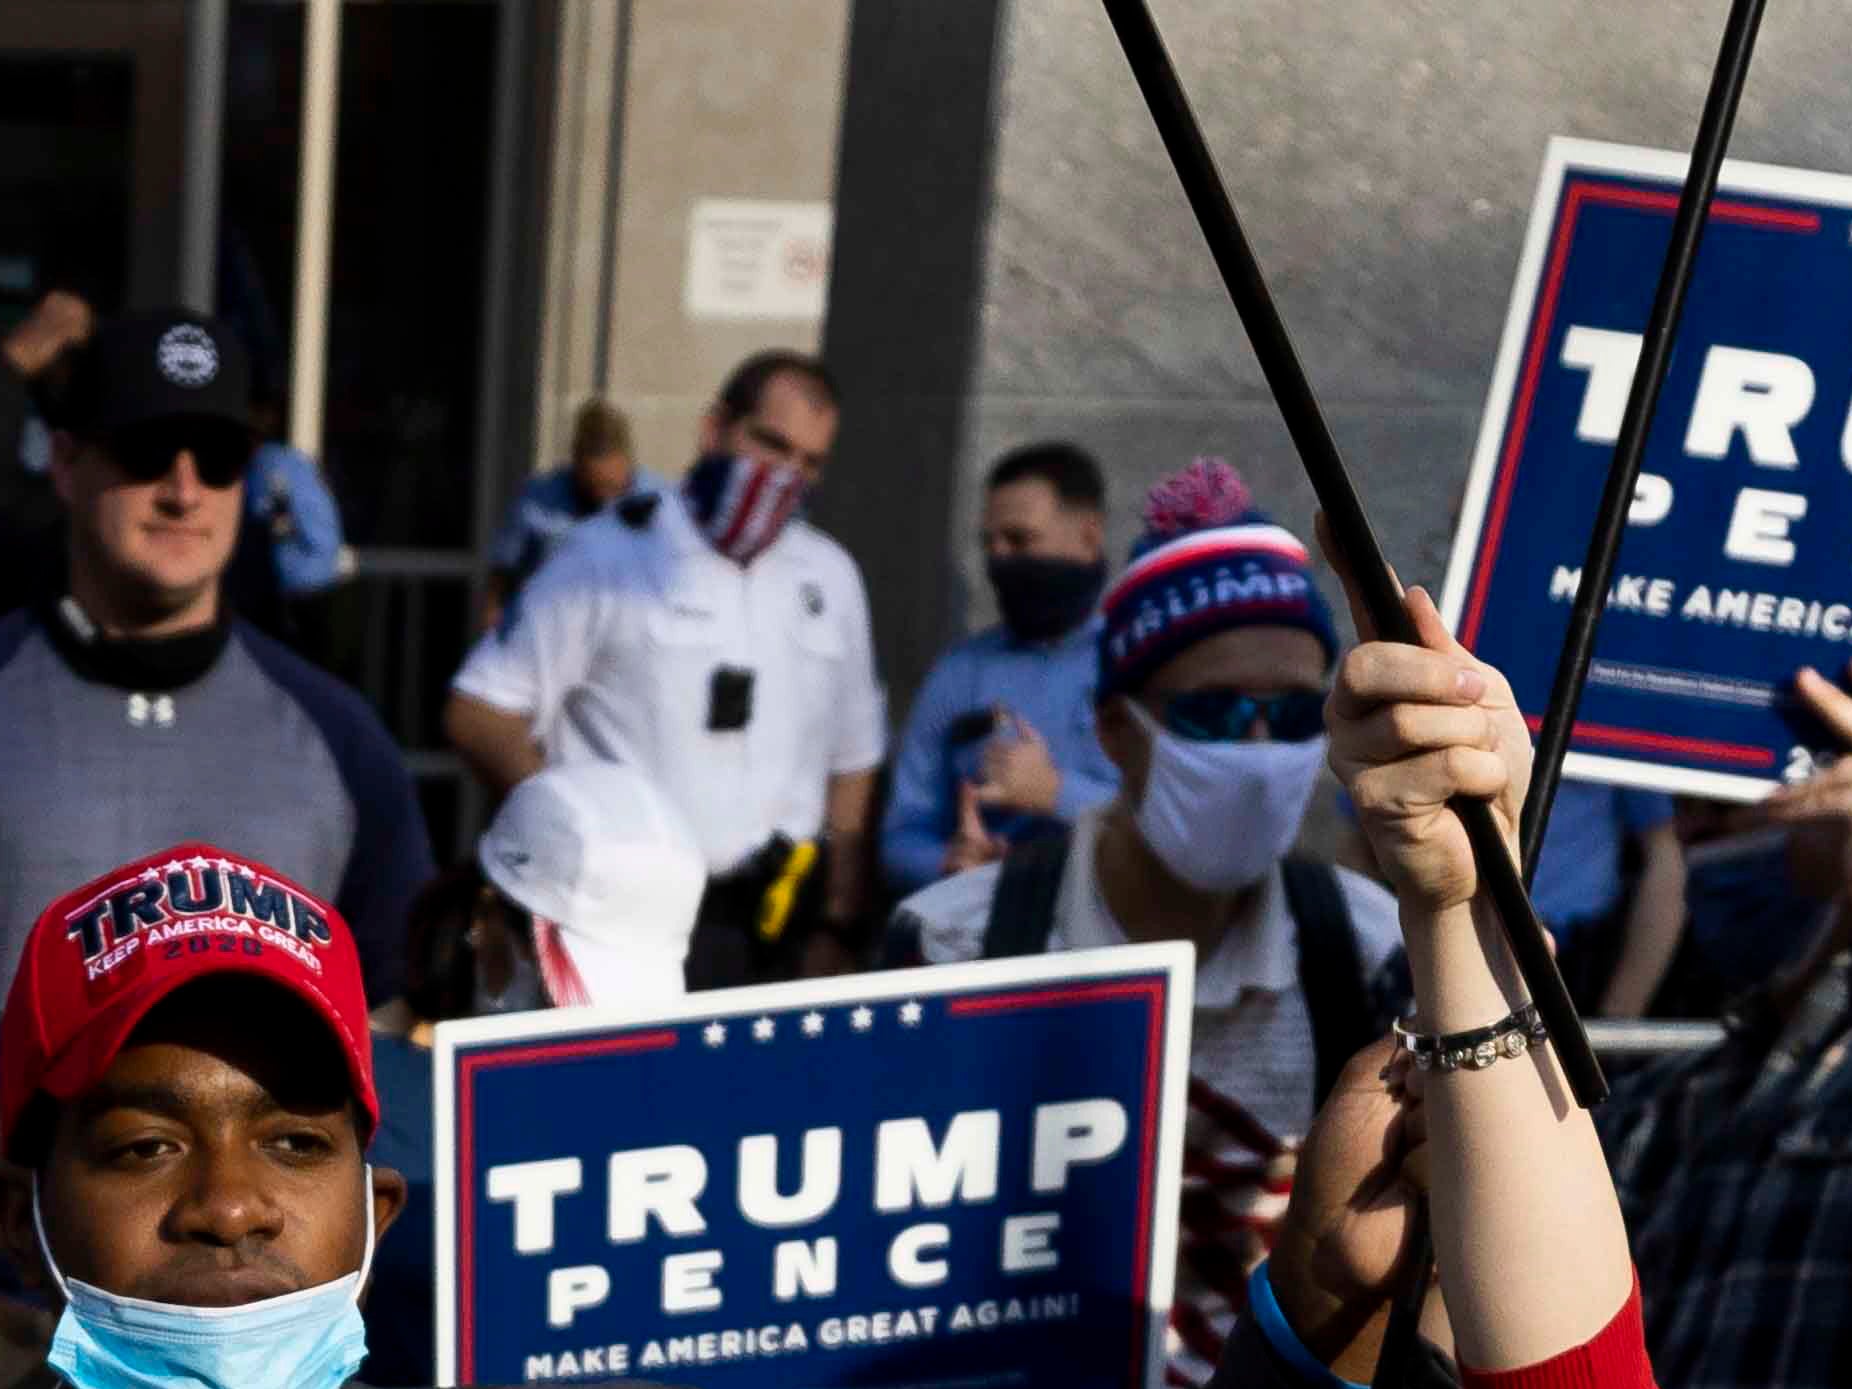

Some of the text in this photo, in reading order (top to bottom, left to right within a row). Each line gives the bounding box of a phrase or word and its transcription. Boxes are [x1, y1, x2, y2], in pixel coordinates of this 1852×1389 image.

[1559, 323, 1852, 477] TR
[1110, 572, 1308, 658] TRUMP
[1549, 565, 1852, 642] MKE AMERIC
[66, 866, 334, 967] TRUMP
[87, 936, 140, 982] KEEP
[147, 915, 255, 946] AMERICA
[164, 934, 264, 961] 2020
[486, 1096, 1129, 1257] TRUMP
[546, 1211, 1063, 1329] PENCE
[525, 1292, 1081, 1381] MAKE AMERICA GREAT AGAIN!
